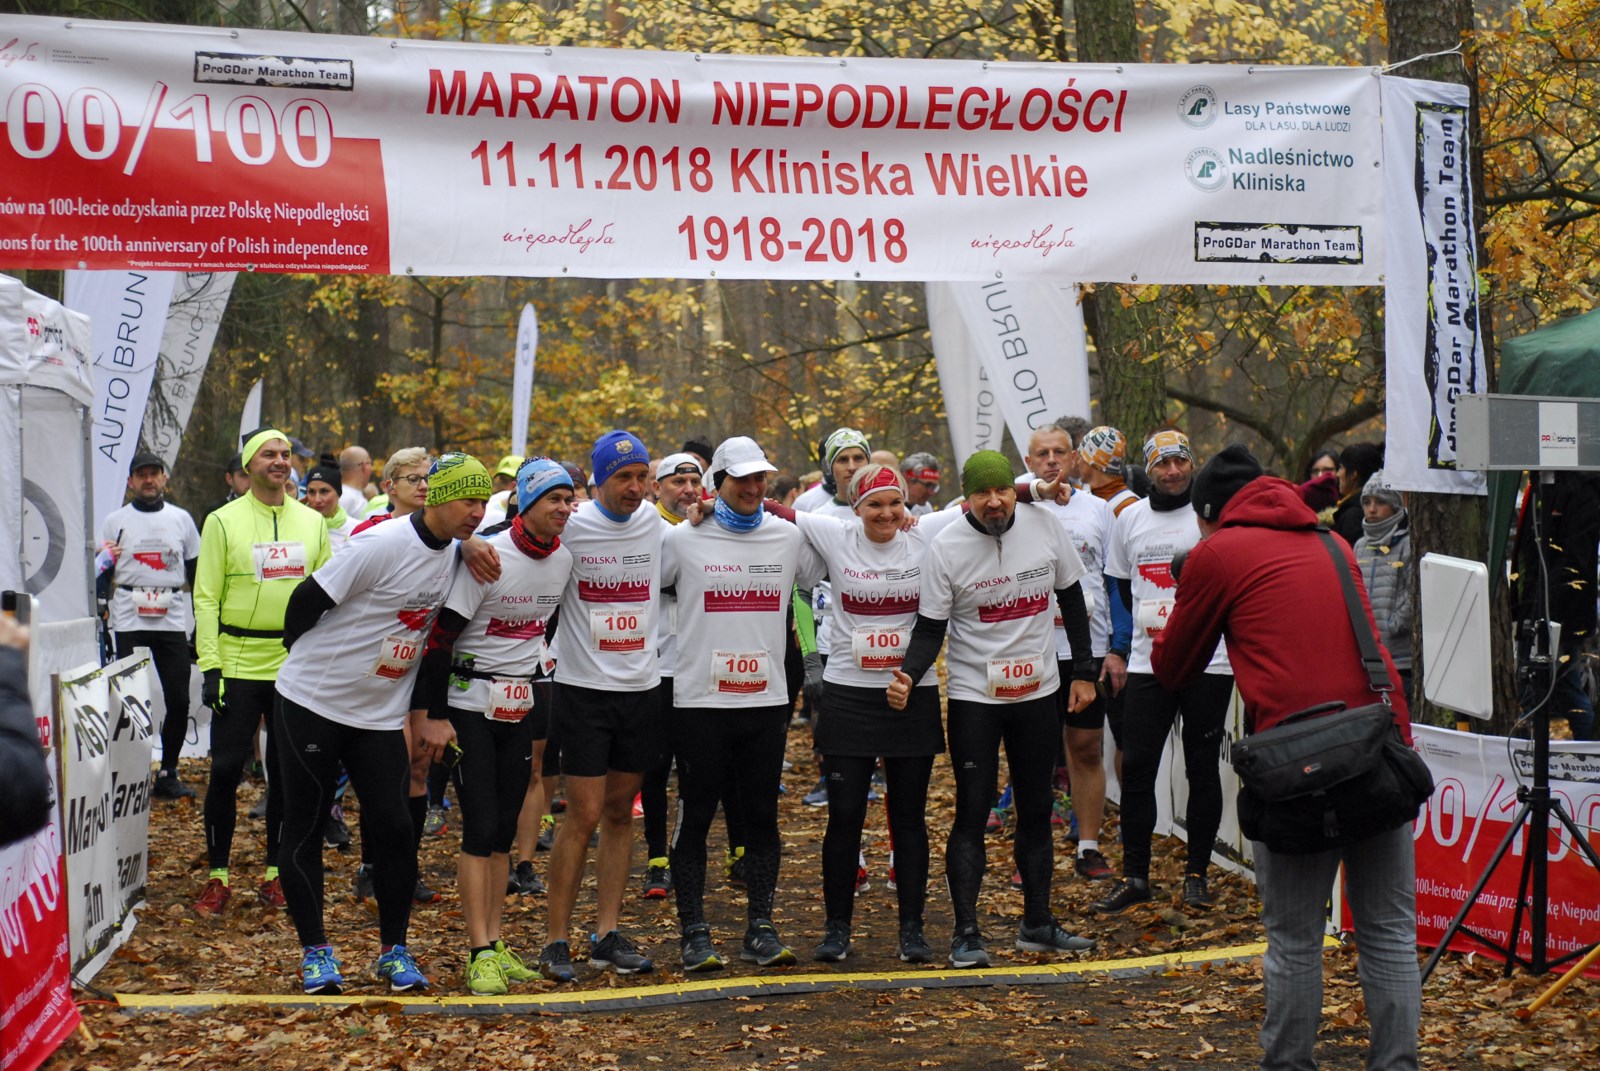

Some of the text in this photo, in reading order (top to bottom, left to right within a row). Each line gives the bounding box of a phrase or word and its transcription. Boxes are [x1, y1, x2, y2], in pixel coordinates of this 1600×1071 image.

[203, 63, 349, 81] ProGDar Marathon Team
[426, 69, 1128, 133] MARATON NIEPODLEGŁOŚCI
[1225, 101, 1351, 118] Lasy Państwowe
[1245, 121, 1351, 133] DLA LASU, DLA LUDZI
[1229, 147, 1354, 168] Nadleśnictwo
[1439, 118, 1455, 184] Team
[471, 140, 1088, 198] 11.11.2018 Kliniska Wielkie
[1232, 172, 1306, 192] Kliniska
[28, 201, 46, 215] na
[49, 198, 110, 216] 100-lecie
[112, 197, 188, 223] odzyskania
[190, 204, 226, 224] przez
[229, 200, 272, 223] Polskę
[274, 202, 369, 227] Niepodległości
[31, 233, 52, 250] for
[55, 234, 78, 251] the
[82, 235, 122, 252] 100th
[126, 237, 208, 259] anniversary
[210, 236, 226, 253] of
[228, 236, 270, 254] Polish
[273, 237, 368, 260] independence
[678, 215, 908, 263] 1918-2018
[1203, 236, 1356, 252] ProGDar Marathon Team
[285, 263, 321, 271] odzyskania
[1440, 195, 1462, 326] Marathon
[99, 376, 130, 463] AUTO
[975, 390, 995, 450] AUTO
[1557, 434, 1576, 445] timing
[269, 547, 289, 560] 21
[581, 556, 617, 565] POLSKA
[704, 564, 743, 573] POLSKA
[843, 567, 880, 580] POLSKA
[974, 575, 1011, 590] POLSKA
[501, 595, 533, 604] POLSKA
[605, 615, 638, 631] 100
[866, 633, 900, 648] 100
[392, 644, 417, 660] 100
[725, 658, 759, 673] 100
[1001, 663, 1033, 679] 100
[504, 684, 529, 700] 100
[1521, 760, 1558, 772] Prar
[1416, 878, 1450, 899] 100-lecie
[1451, 884, 1498, 906] odzyania
[1500, 896, 1518, 912] prz
[1417, 913, 1431, 927] the
